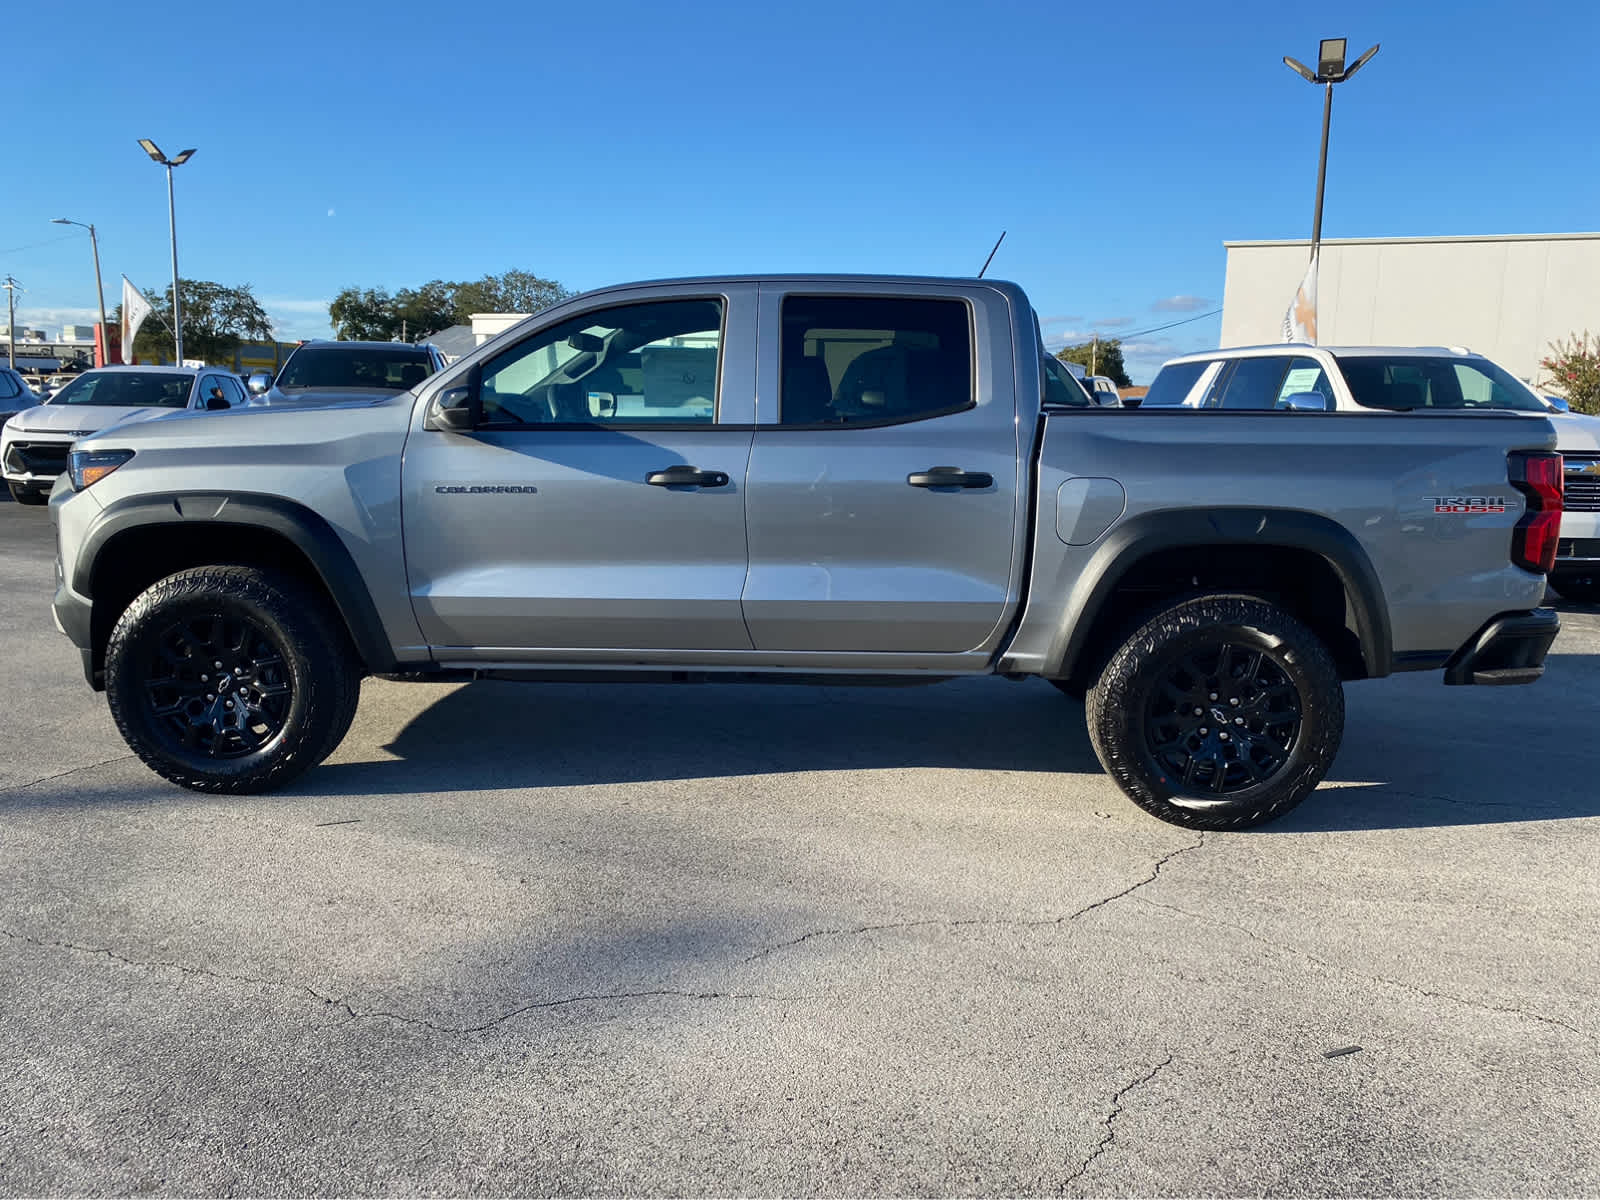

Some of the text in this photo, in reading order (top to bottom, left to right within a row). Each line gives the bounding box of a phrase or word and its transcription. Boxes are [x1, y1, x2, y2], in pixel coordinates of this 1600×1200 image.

[435, 486, 538, 494] COLORADO
[1423, 496, 1517, 506] TRAIL
[1434, 505, 1505, 513] BOSS
